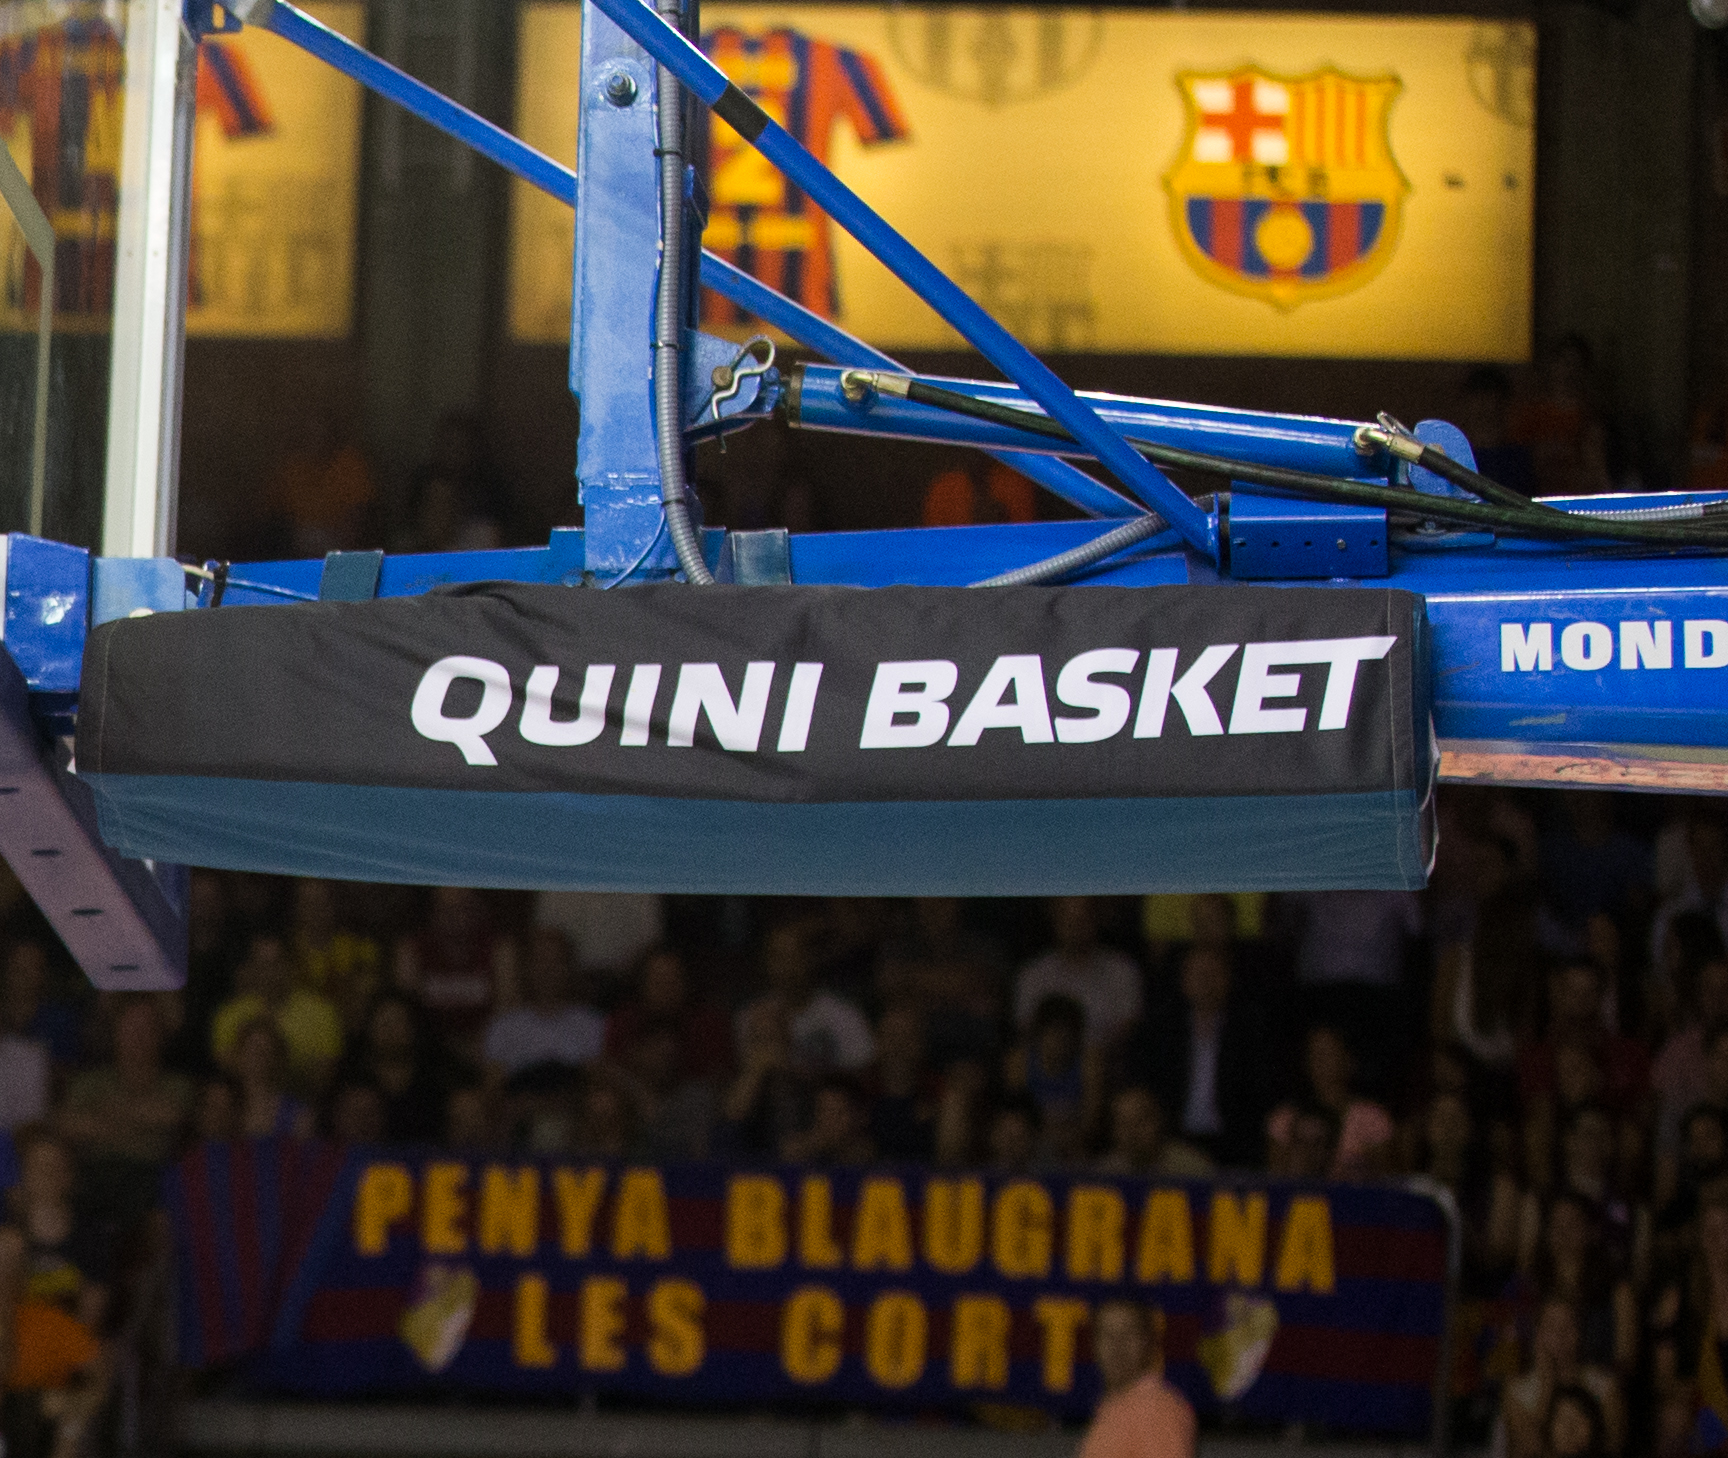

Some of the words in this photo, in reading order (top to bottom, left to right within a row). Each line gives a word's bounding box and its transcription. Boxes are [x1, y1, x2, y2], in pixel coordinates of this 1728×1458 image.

[410, 655, 824, 766] QUINI
[859, 636, 1397, 749] BASKET
[352, 1163, 672, 1260] PENYA
[726, 1174, 1337, 1294] BLAUGRANA
[512, 1273, 708, 1376] LES
[780, 1284, 1166, 1394] CORT
